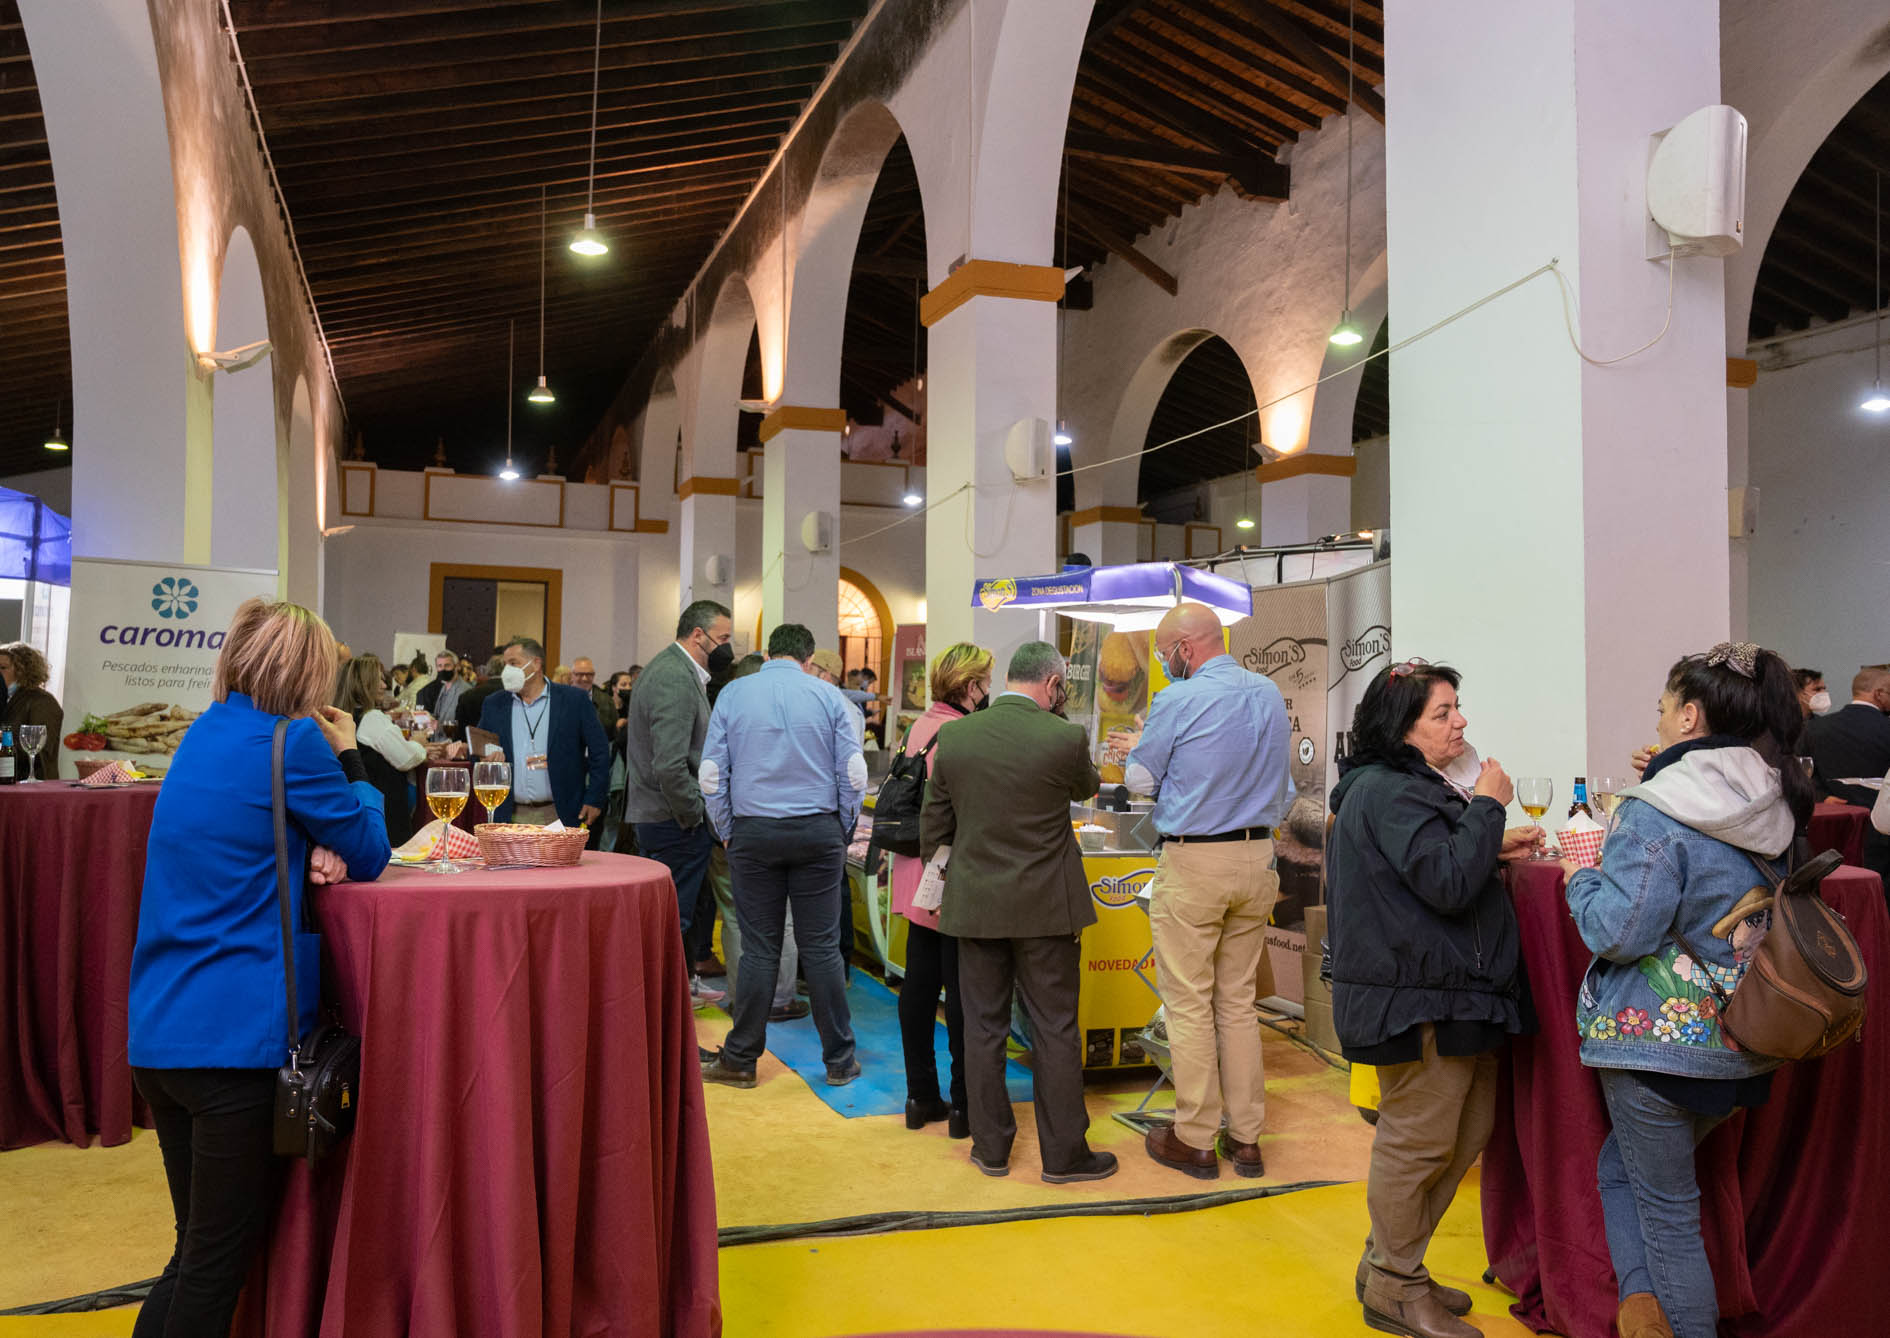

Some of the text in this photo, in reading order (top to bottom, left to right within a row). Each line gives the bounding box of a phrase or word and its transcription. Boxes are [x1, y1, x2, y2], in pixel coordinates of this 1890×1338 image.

[102, 660, 158, 673] Pescados
[125, 675, 155, 687] listos
[157, 678, 185, 689] para
[1263, 936, 1306, 952] nsfood.net
